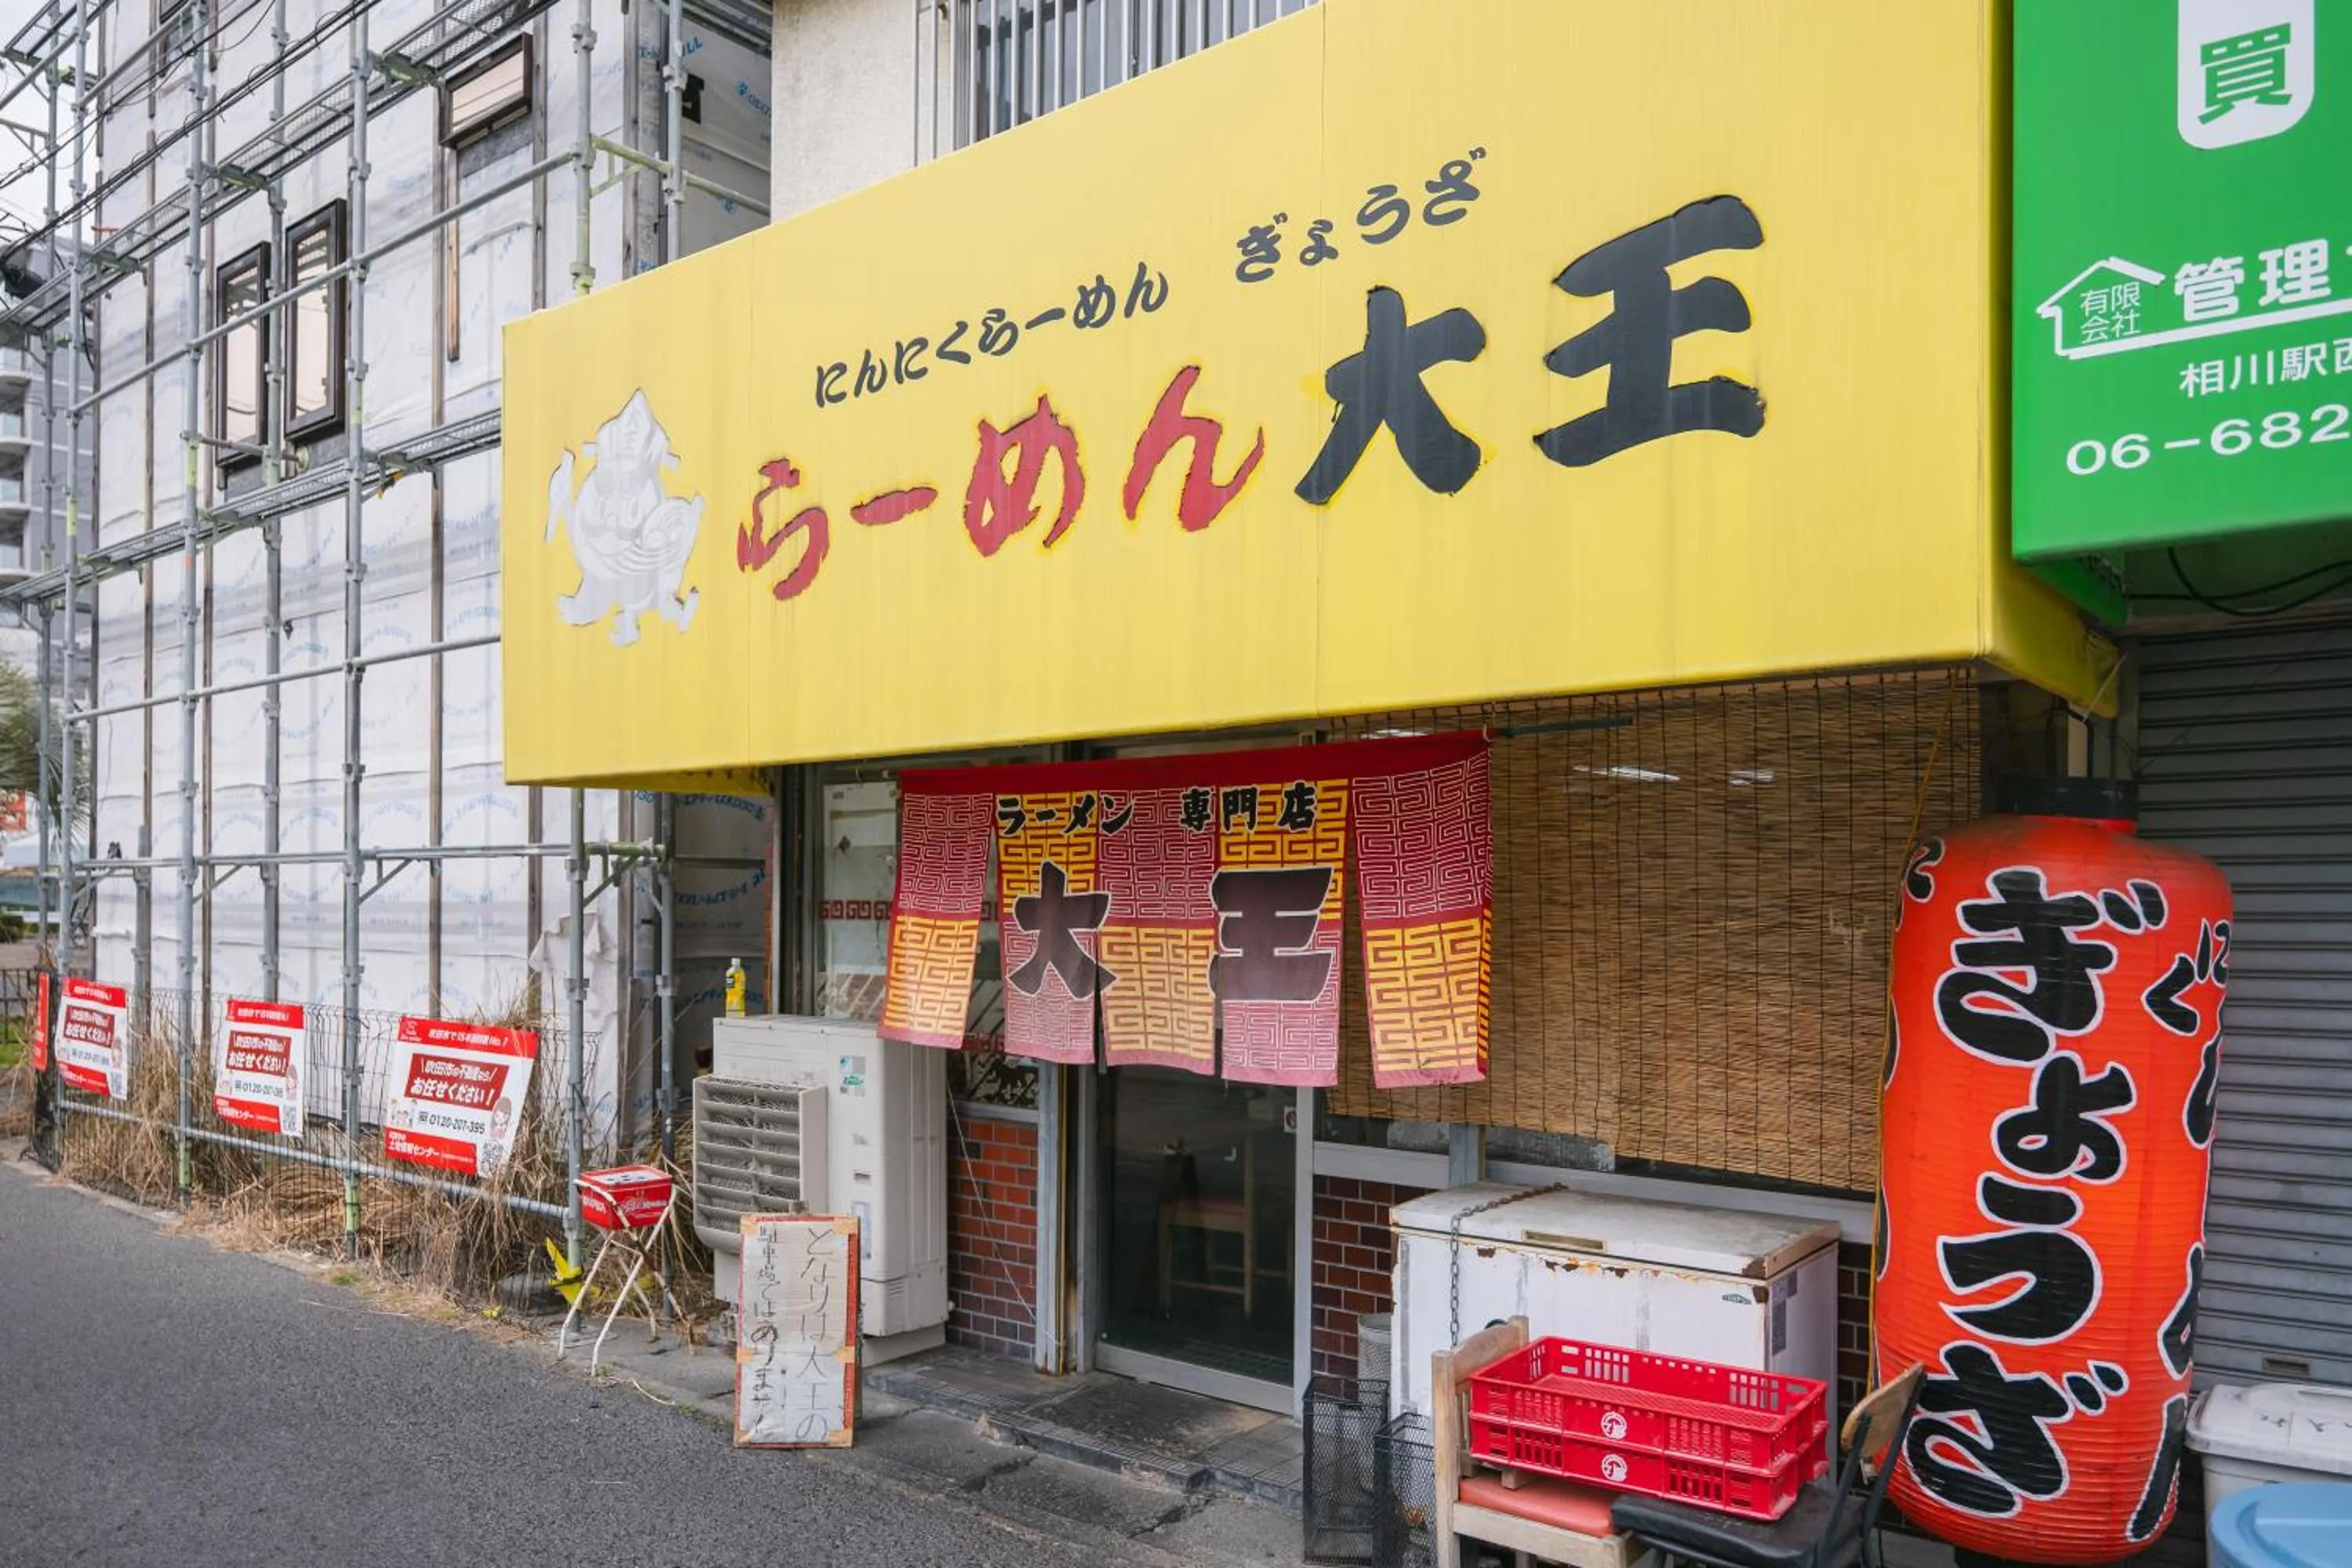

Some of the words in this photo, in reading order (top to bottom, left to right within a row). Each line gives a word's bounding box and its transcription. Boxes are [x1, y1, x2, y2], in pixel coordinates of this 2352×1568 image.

[2197, 22, 2292, 125] 買
[815, 261, 1169, 408] にんにくらーめん
[1235, 147, 1486, 282] ぎょうざ
[2079, 281, 2140, 317] 有限
[2080, 308, 2141, 344] 会社
[2174, 238, 2352, 322] 管理
[737, 365, 1265, 601] らーめん
[1294, 194, 1766, 505] 大王
[996, 792, 1134, 837] ラーメン
[1180, 780, 1318, 832] 専門店
[1006, 859, 1334, 1003] 大王
[1903, 865, 2169, 1519] ぎょうざ
